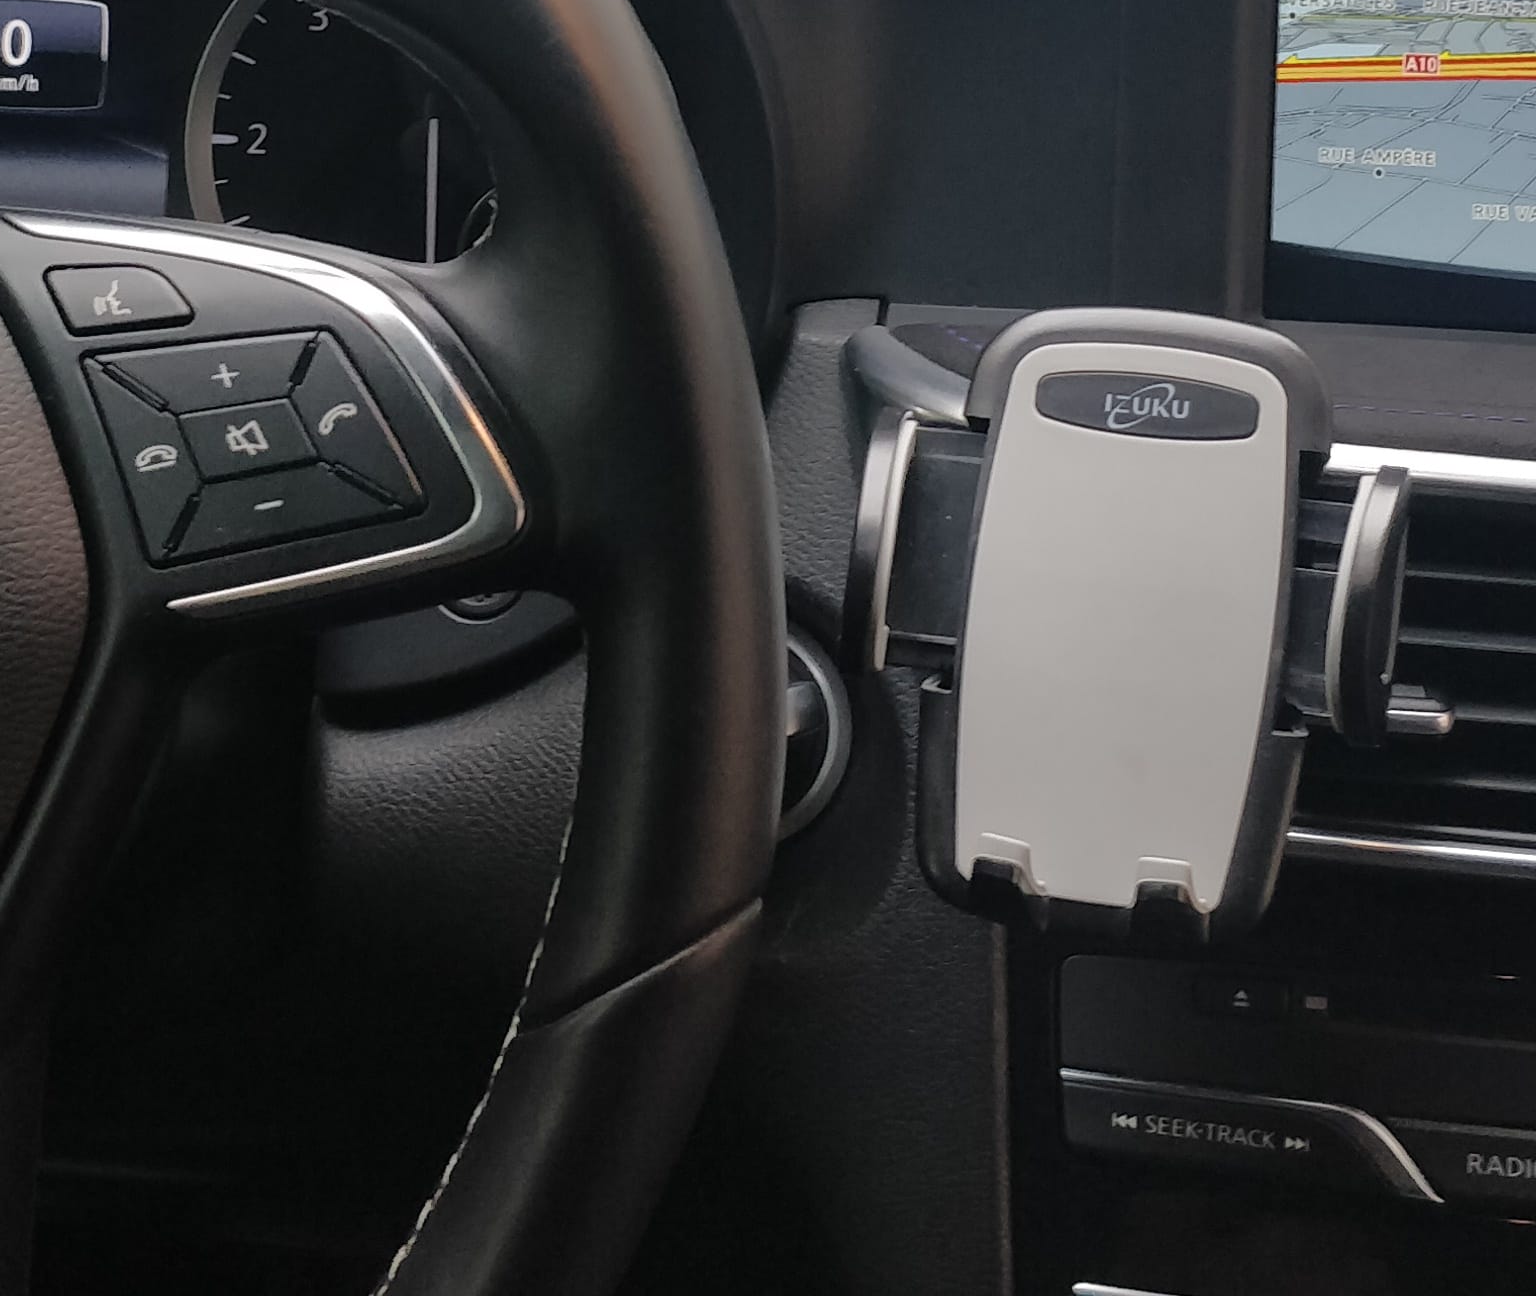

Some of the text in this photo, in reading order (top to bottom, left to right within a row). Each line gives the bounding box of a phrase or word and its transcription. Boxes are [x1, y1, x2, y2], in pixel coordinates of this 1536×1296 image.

[309, 6, 329, 31] 3
[0, 19, 33, 67] 0
[1405, 54, 1439, 74] A10
[246, 123, 268, 155] 2
[1318, 147, 1355, 164] RUE
[1471, 203, 1510, 221] RUE
